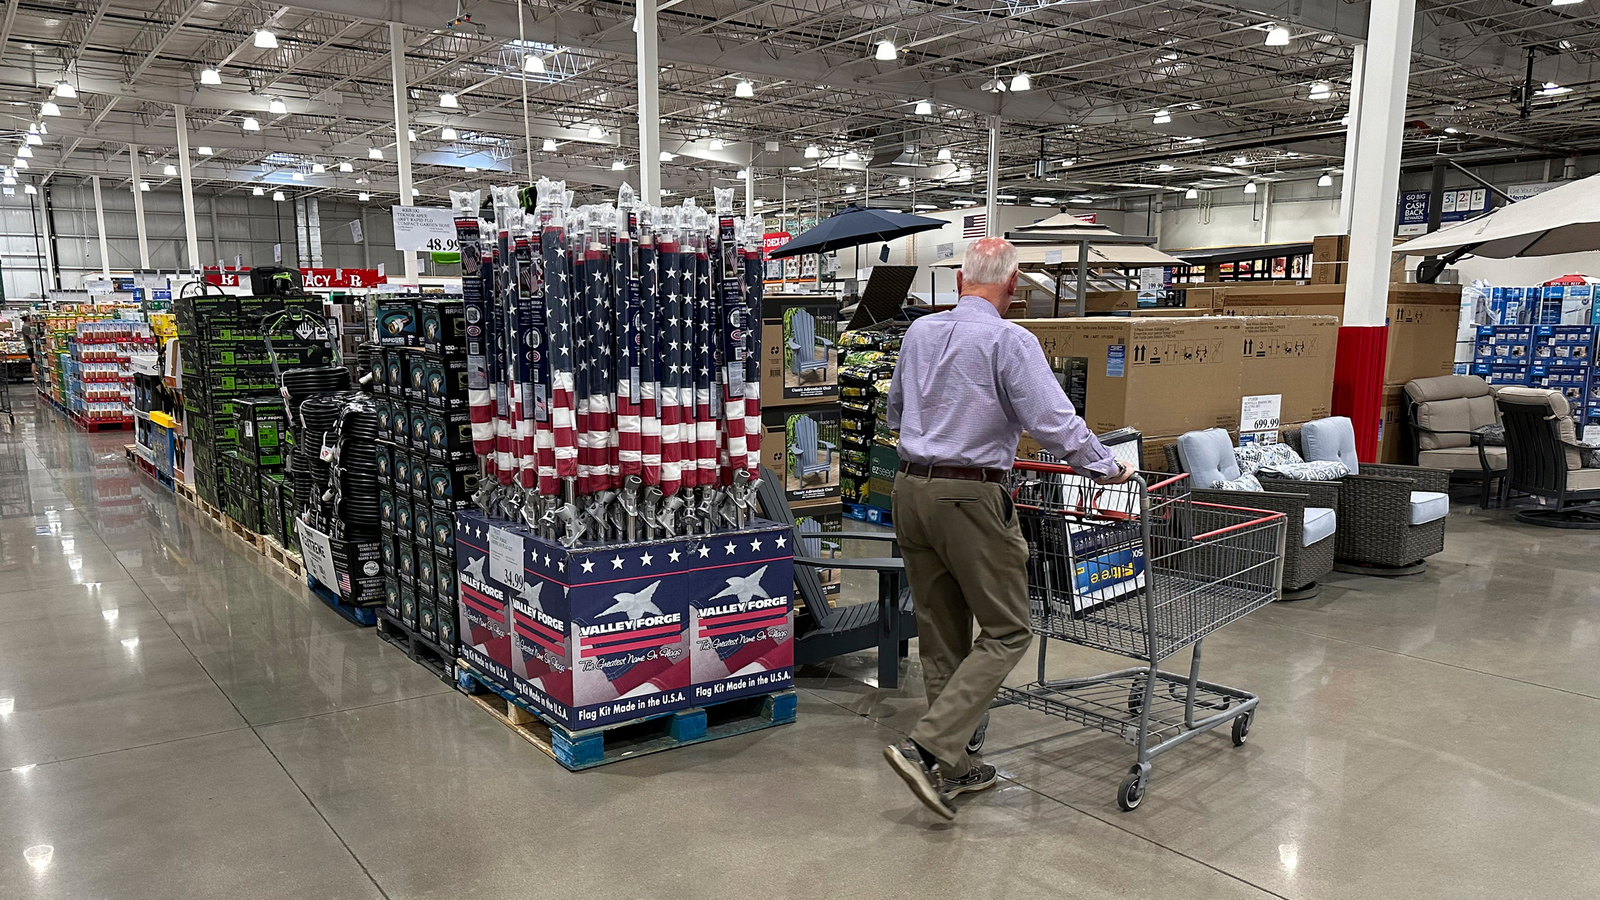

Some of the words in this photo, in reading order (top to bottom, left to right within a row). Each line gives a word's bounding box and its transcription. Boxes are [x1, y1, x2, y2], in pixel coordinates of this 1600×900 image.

[426, 238, 460, 251] 48.99
[302, 275, 331, 287] ACY
[1254, 418, 1279, 429] 699.99
[504, 569, 524, 589] 34.99
[1091, 562, 1133, 583] Filtree
[460, 572, 480, 590] VALLEY
[480, 582, 504, 600] FORGE
[513, 598, 536, 618] VALLEY
[537, 611, 564, 631] FORGE
[699, 602, 745, 617] VALLEY
[748, 596, 787, 610] FORGE
[580, 620, 633, 635] VALLEY
[637, 613, 680, 628] FORGE
[696, 640, 710, 651] The
[712, 637, 739, 649] Greatest
[740, 634, 755, 644] Name
[768, 628, 788, 640] Flags
[475, 651, 484, 667] Made
[484, 659, 489, 669] in
[496, 665, 509, 682] U.S.A.
[578, 661, 595, 672] The
[596, 657, 626, 670] Greatest
[627, 653, 645, 664] Name
[660, 647, 681, 659] Flags
[696, 687, 712, 697] Flag
[714, 683, 724, 694] Kit
[727, 679, 746, 691] Made
[748, 678, 756, 687] in
[757, 675, 768, 684] the
[770, 671, 791, 682] U.S.A.
[514, 678, 522, 694] Flag
[529, 688, 540, 703] Made
[541, 695, 546, 706] in
[554, 701, 568, 720] U.S.A.
[578, 710, 596, 721] Flag
[599, 706, 611, 716] Kit
[613, 701, 635, 714] Made
[638, 700, 645, 709] in
[648, 697, 660, 707] the
[662, 692, 686, 704] U.S.A.
